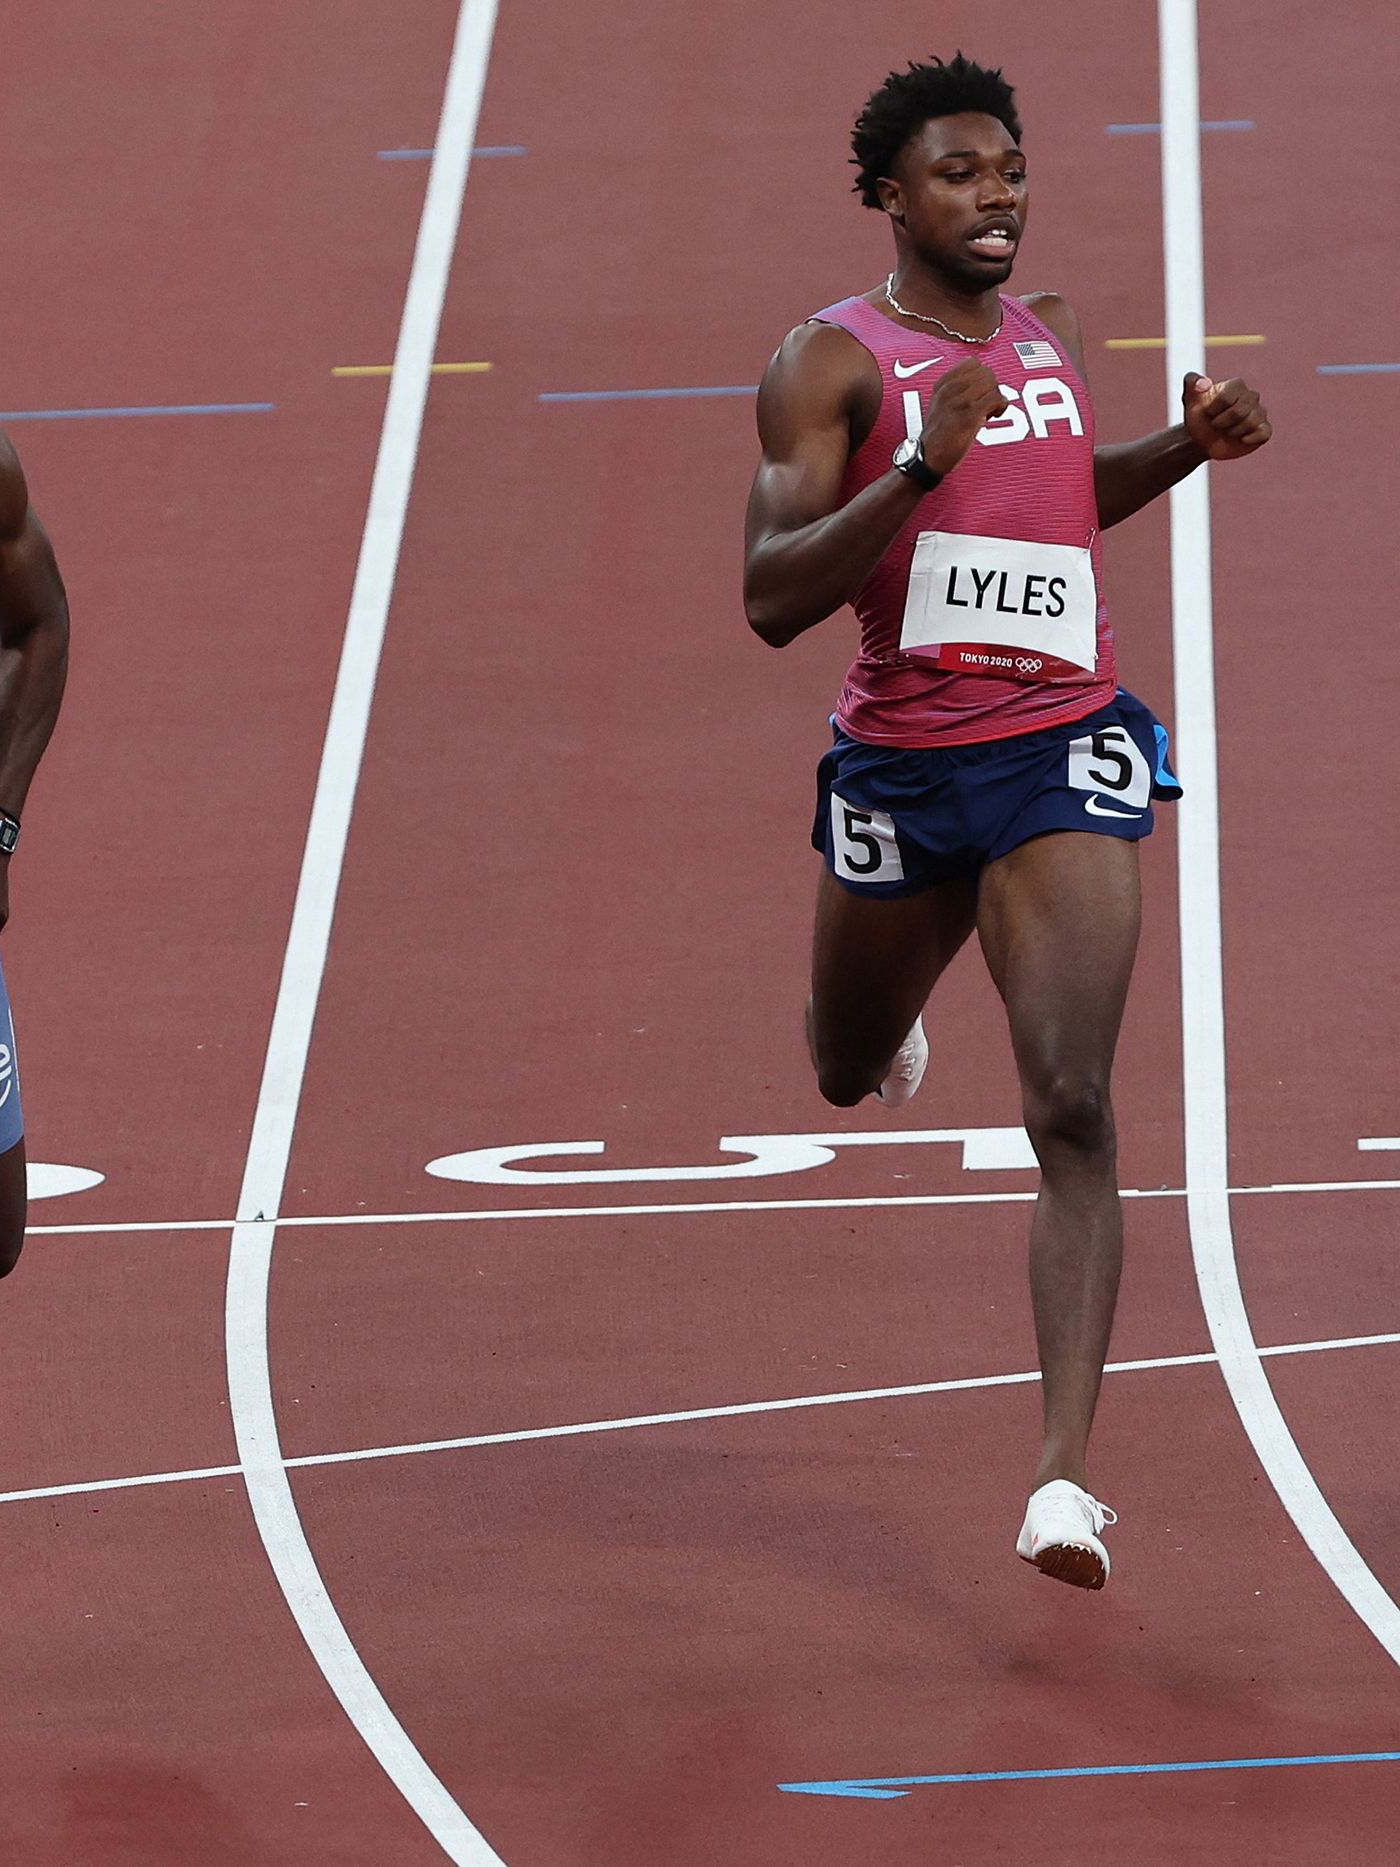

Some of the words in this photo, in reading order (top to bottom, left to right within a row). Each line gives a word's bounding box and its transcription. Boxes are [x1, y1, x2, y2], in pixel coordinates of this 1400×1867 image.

[946, 565, 1067, 618] LYLES
[959, 651, 988, 665] TOKYO
[989, 656, 1013, 668] 2020
[1087, 732, 1133, 791] 5
[843, 805, 883, 875] 5
[425, 1127, 1039, 1184] 5
